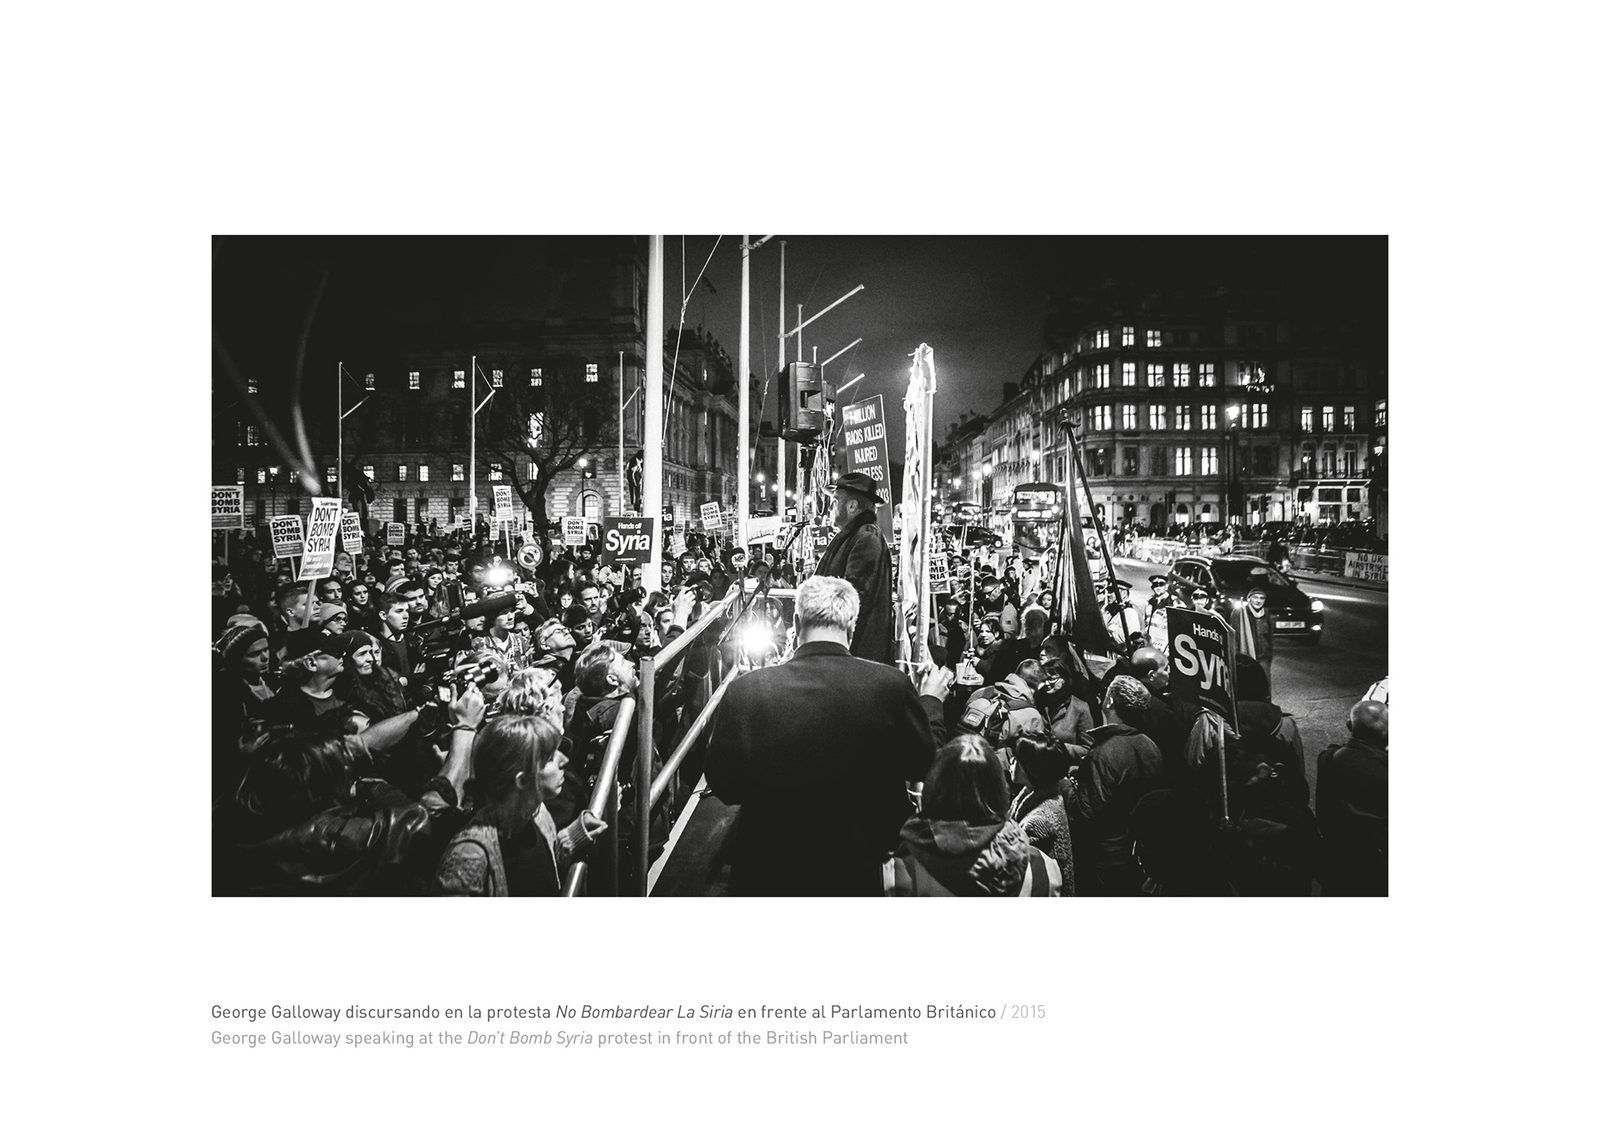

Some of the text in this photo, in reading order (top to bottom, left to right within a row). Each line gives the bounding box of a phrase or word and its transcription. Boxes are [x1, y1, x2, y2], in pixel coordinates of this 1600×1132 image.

[864, 423, 884, 442] KILLED
[854, 446, 878, 464] INJURED
[211, 491, 241, 499] DON'T
[211, 506, 241, 514] SYRIA
[314, 507, 339, 522] DON'T
[272, 520, 299, 529] DON'T
[309, 522, 335, 537] BOMB
[618, 522, 643, 530] Hands off
[273, 527, 301, 536] BOMB
[274, 534, 302, 543] SYRIA
[605, 529, 650, 556] Syria
[307, 537, 332, 553] SYRIA
[930, 558, 944, 566] N'T
[1193, 623, 1219, 642] Hands
